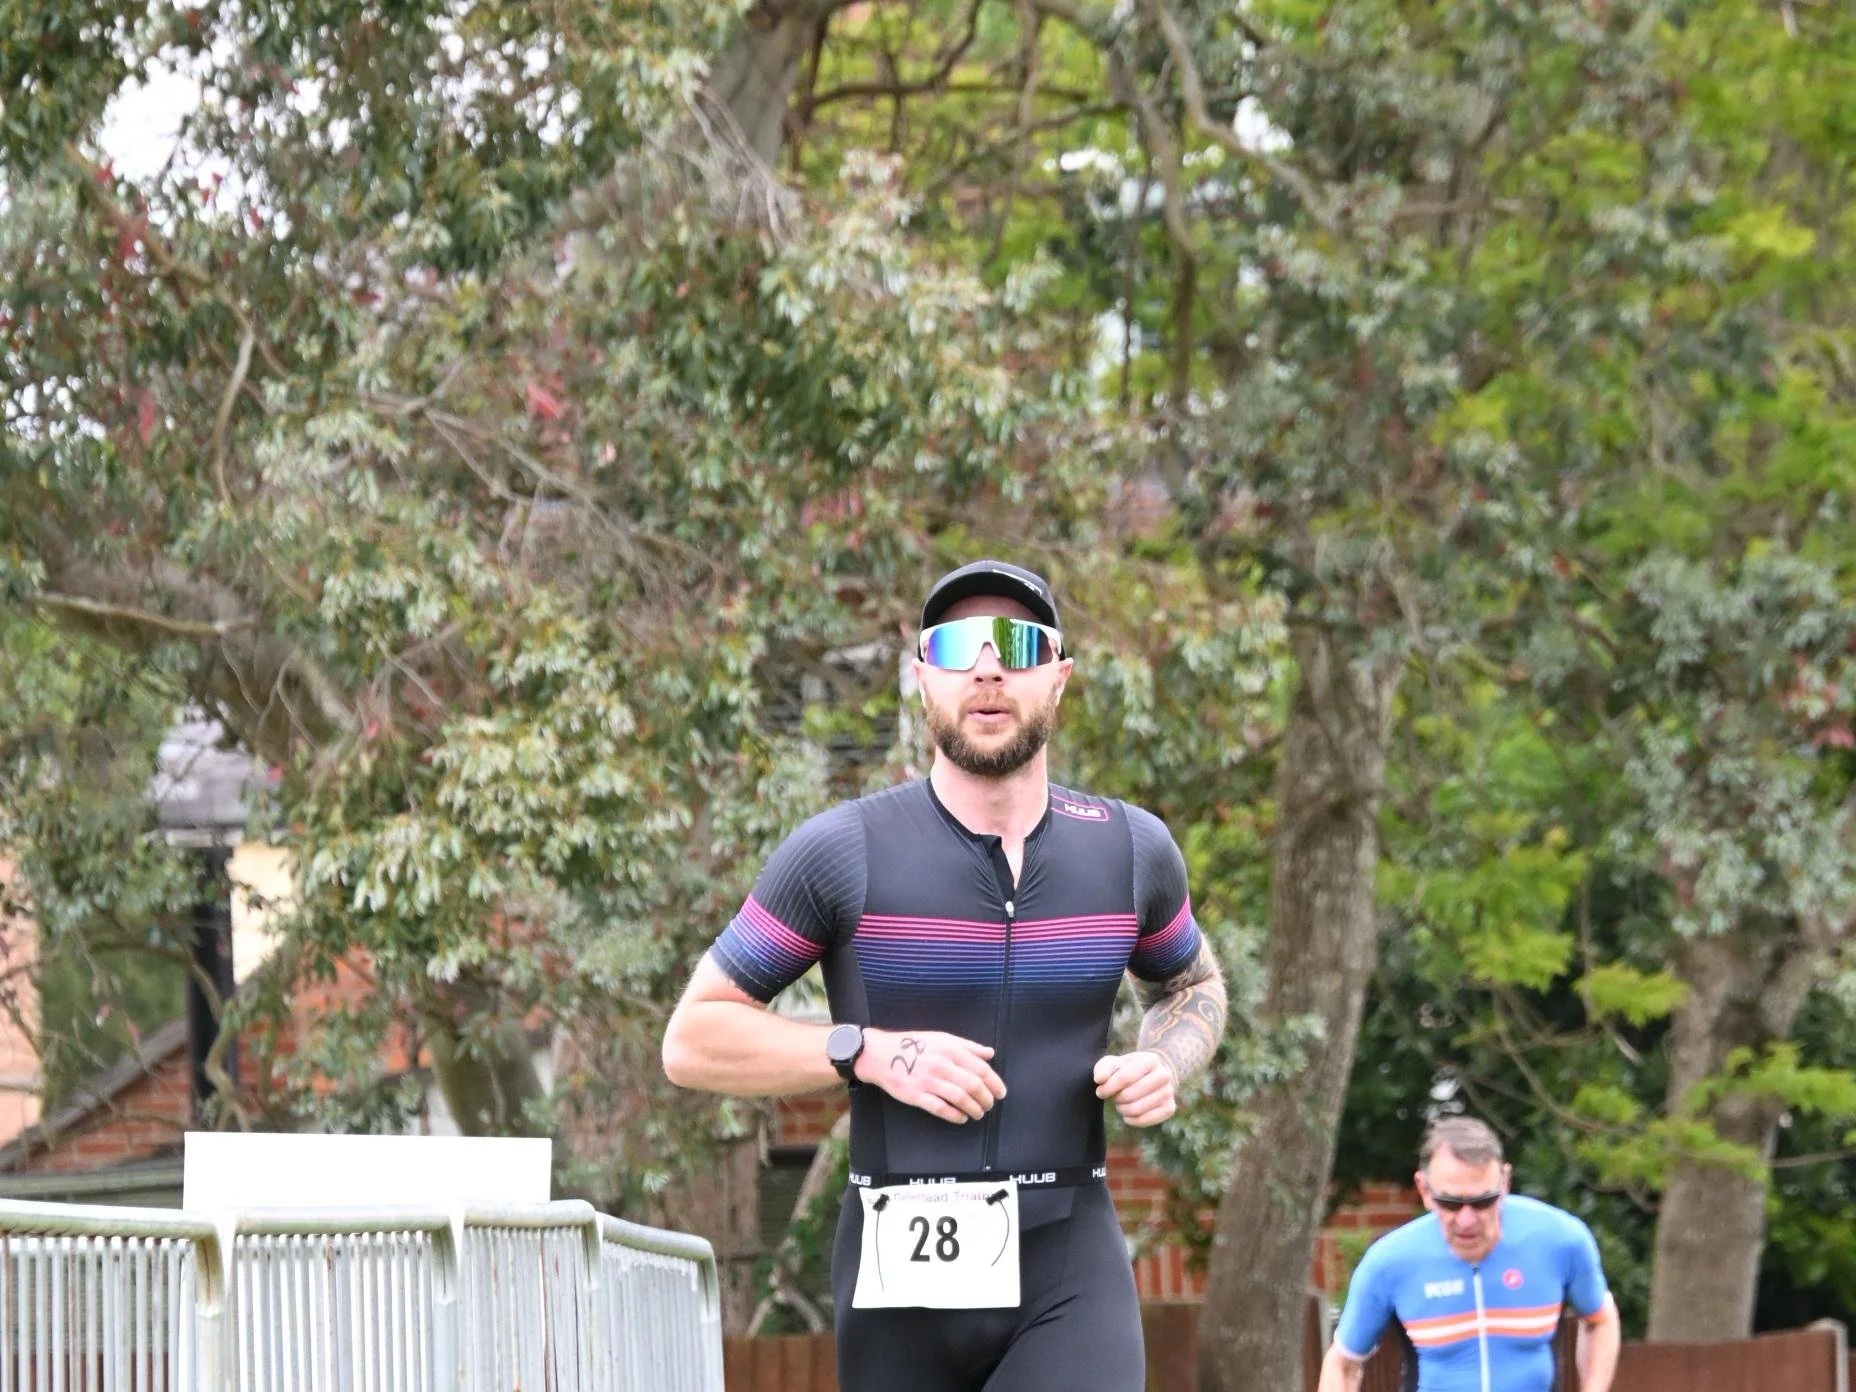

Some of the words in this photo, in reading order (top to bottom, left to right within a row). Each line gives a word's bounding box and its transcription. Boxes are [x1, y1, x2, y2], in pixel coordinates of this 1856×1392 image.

[890, 1037, 926, 1076] 28
[1009, 1172, 1057, 1184] HUUB
[908, 1215, 960, 1262] 28
